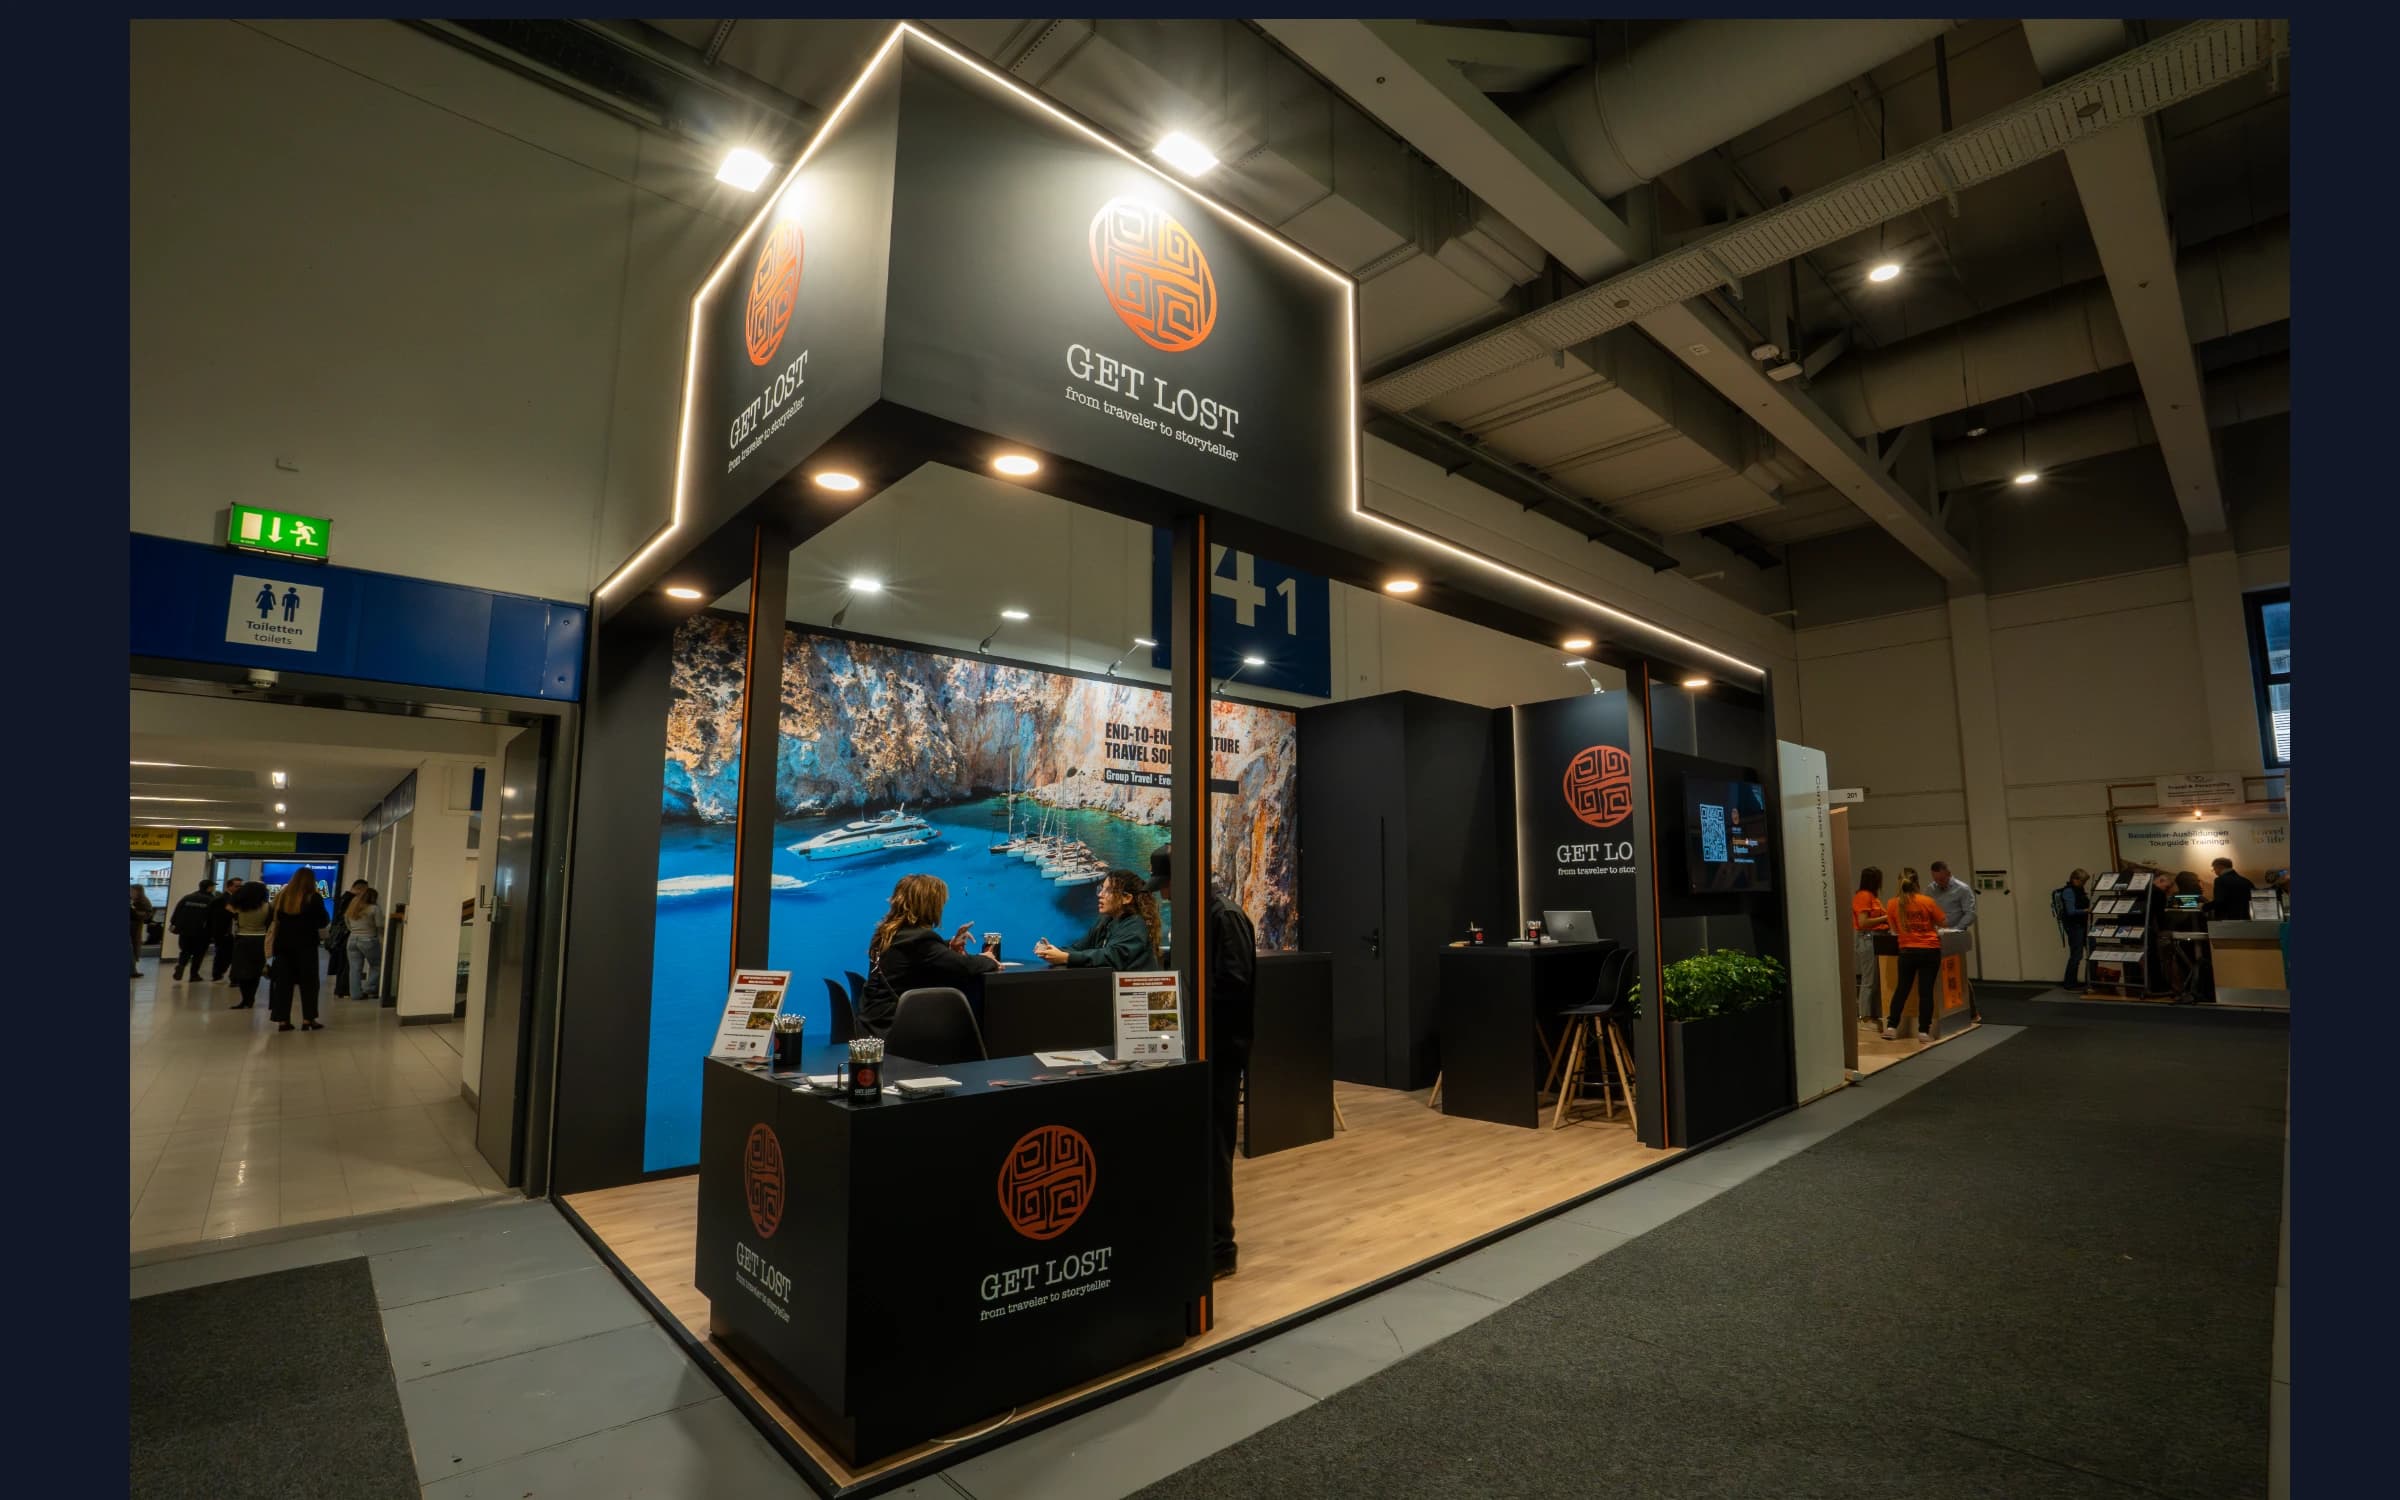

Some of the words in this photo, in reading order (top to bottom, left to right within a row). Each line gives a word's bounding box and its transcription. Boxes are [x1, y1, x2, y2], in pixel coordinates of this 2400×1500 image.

[730, 396, 761, 450] GET
[762, 349, 808, 420] LOST
[1066, 343, 1145, 400] GET
[1153, 377, 1239, 438] LOST
[728, 455, 741, 474] from
[741, 434, 764, 461] traveler
[764, 428, 771, 440] to
[771, 396, 805, 434] storyteller
[1065, 386, 1101, 411] from
[1103, 400, 1157, 431] traveler
[1160, 422, 1173, 437] to
[1175, 429, 1239, 462] storyteller
[245, 620, 303, 636] Toiletten
[254, 632, 293, 645] toilets
[1105, 742, 1149, 763] TRAVEL
[1210, 735, 1240, 755] TURE
[1106, 769, 1129, 784] Group
[1131, 771, 1153, 784] Travel
[1556, 843, 1599, 863] GET
[1603, 841, 1633, 861] LO
[1558, 867, 1576, 876] from
[1577, 866, 1608, 875] traveler
[736, 1241, 759, 1278] GET
[760, 1258, 791, 1304] LOST
[980, 1264, 1039, 1301] GET
[1045, 1246, 1112, 1285] LOST
[980, 1306, 1006, 1321] from
[1008, 1296, 1049, 1313] traveler
[1050, 1292, 1060, 1302] to
[1061, 1279, 1111, 1299] storyteller
